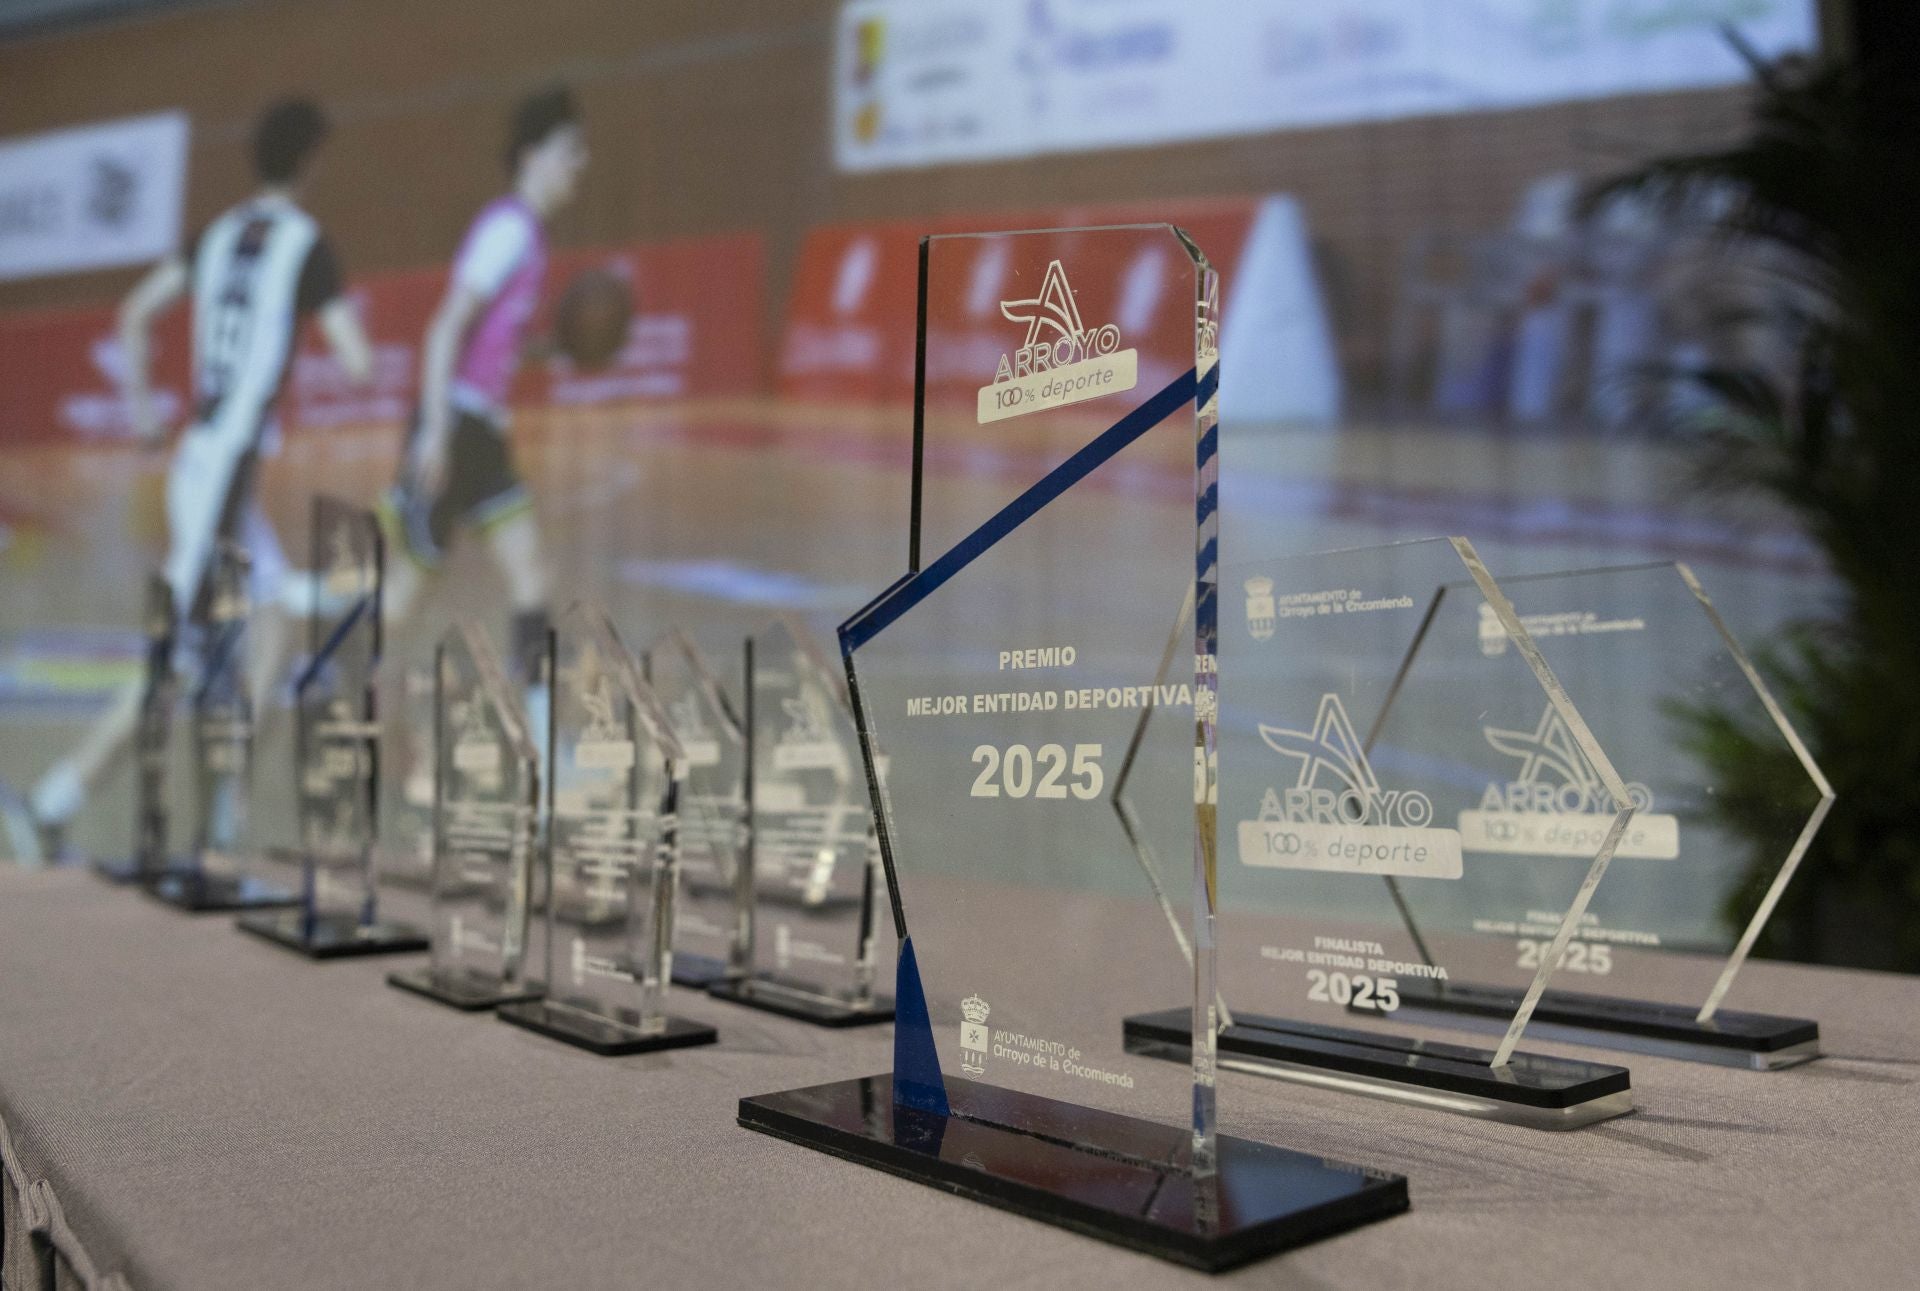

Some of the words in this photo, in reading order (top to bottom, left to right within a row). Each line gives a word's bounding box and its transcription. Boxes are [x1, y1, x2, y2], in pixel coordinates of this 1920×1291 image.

[993, 324, 1120, 385] ARROYO
[996, 387, 1035, 409] 100%
[1042, 369, 1113, 401] deporte
[1333, 602, 1343, 613] la
[1000, 647, 1076, 669] PREMIO
[907, 696, 967, 716] MEJOR
[973, 690, 1058, 713] ENTIDAD
[1064, 684, 1192, 710] DEPORTIVA
[970, 744, 1104, 799] 2025
[1257, 787, 1433, 828] ARROYO
[1327, 836, 1427, 865] deporte
[1314, 936, 1384, 956] FINALISTA
[1307, 951, 1364, 970] ENTIDAD
[1367, 958, 1449, 980] DEPORTIVA
[1306, 968, 1400, 1012] 2025
[994, 1030, 1065, 1056] AYUNTAMIENTO
[1068, 1047, 1080, 1060] de
[1033, 1053, 1046, 1067] de
[1050, 1056, 1059, 1071] la
